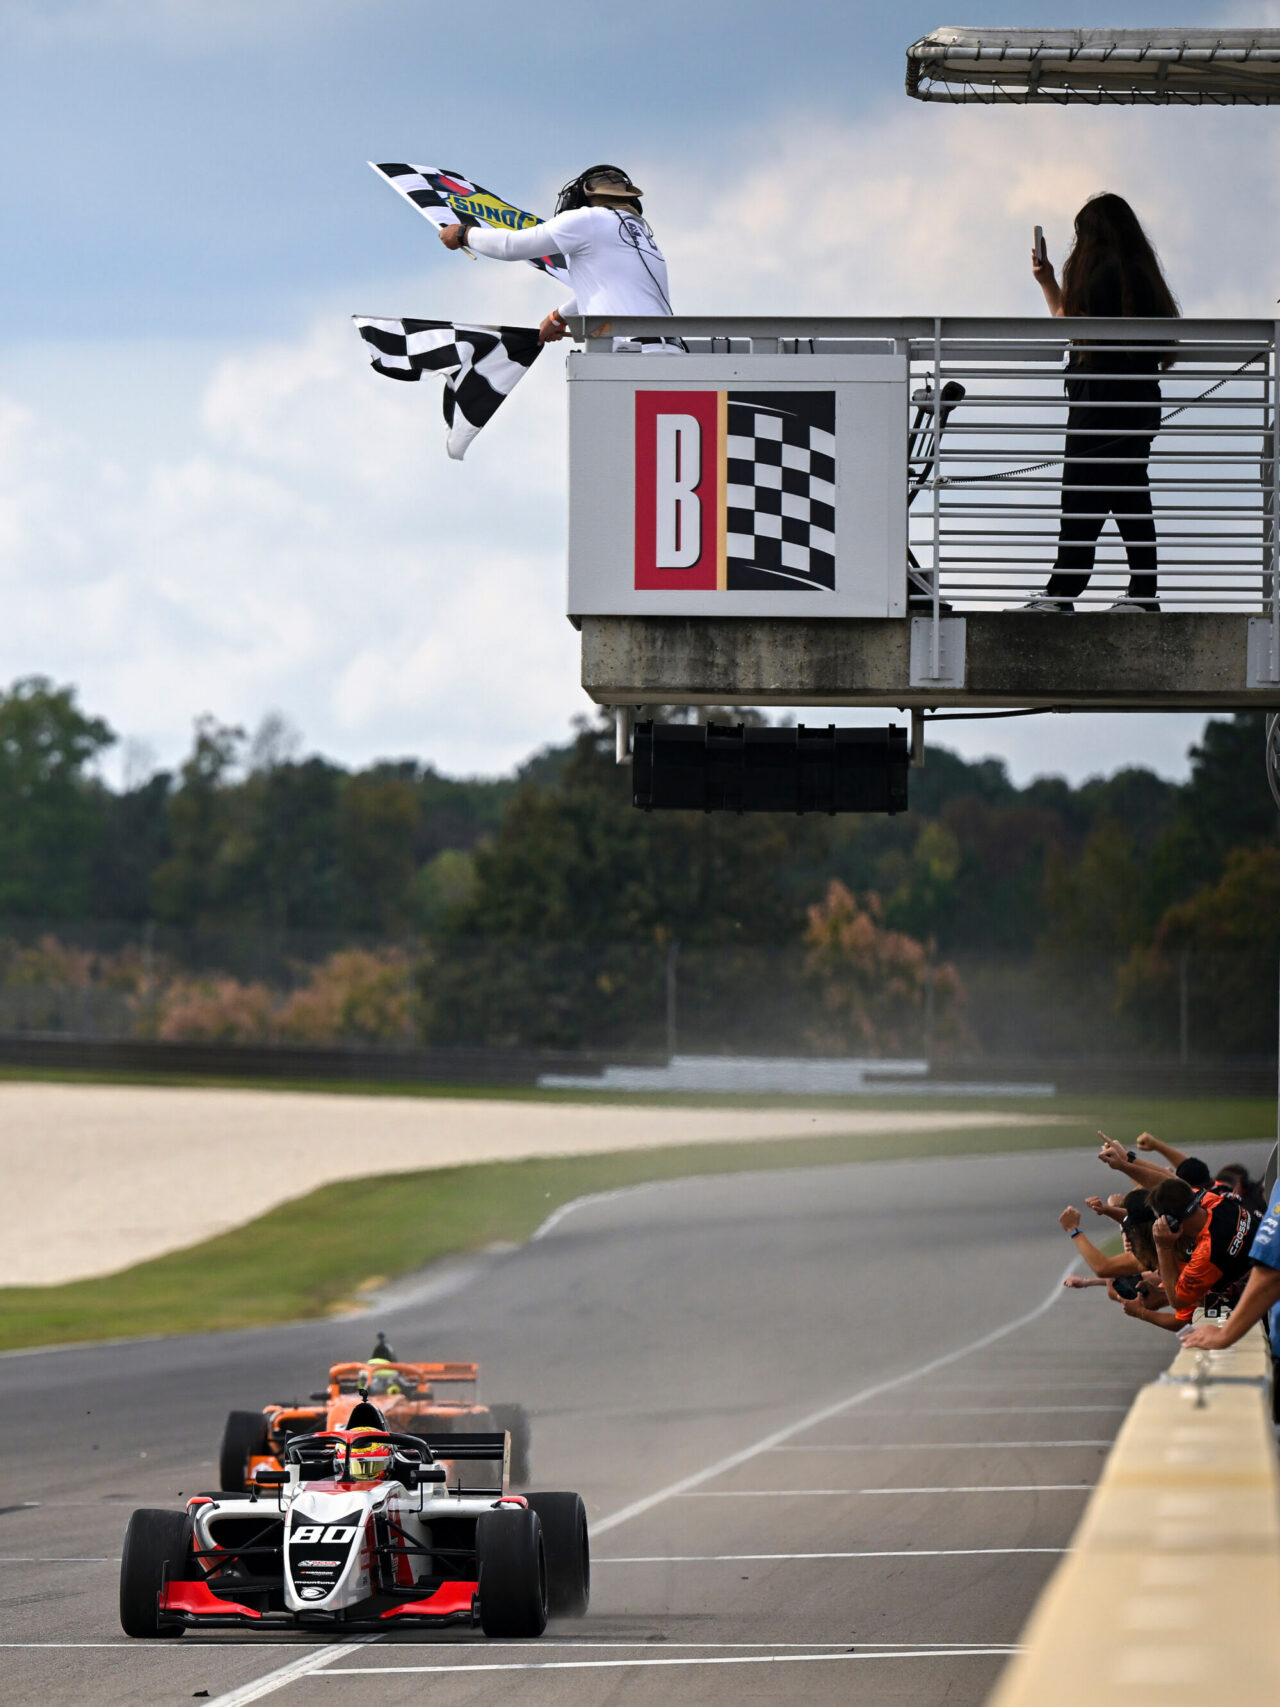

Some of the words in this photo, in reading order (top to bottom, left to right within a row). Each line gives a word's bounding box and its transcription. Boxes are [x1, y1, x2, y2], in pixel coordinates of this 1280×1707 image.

[453, 196, 546, 231] SUNOC
[656, 413, 701, 568] B
[289, 1526, 357, 1543] 80
